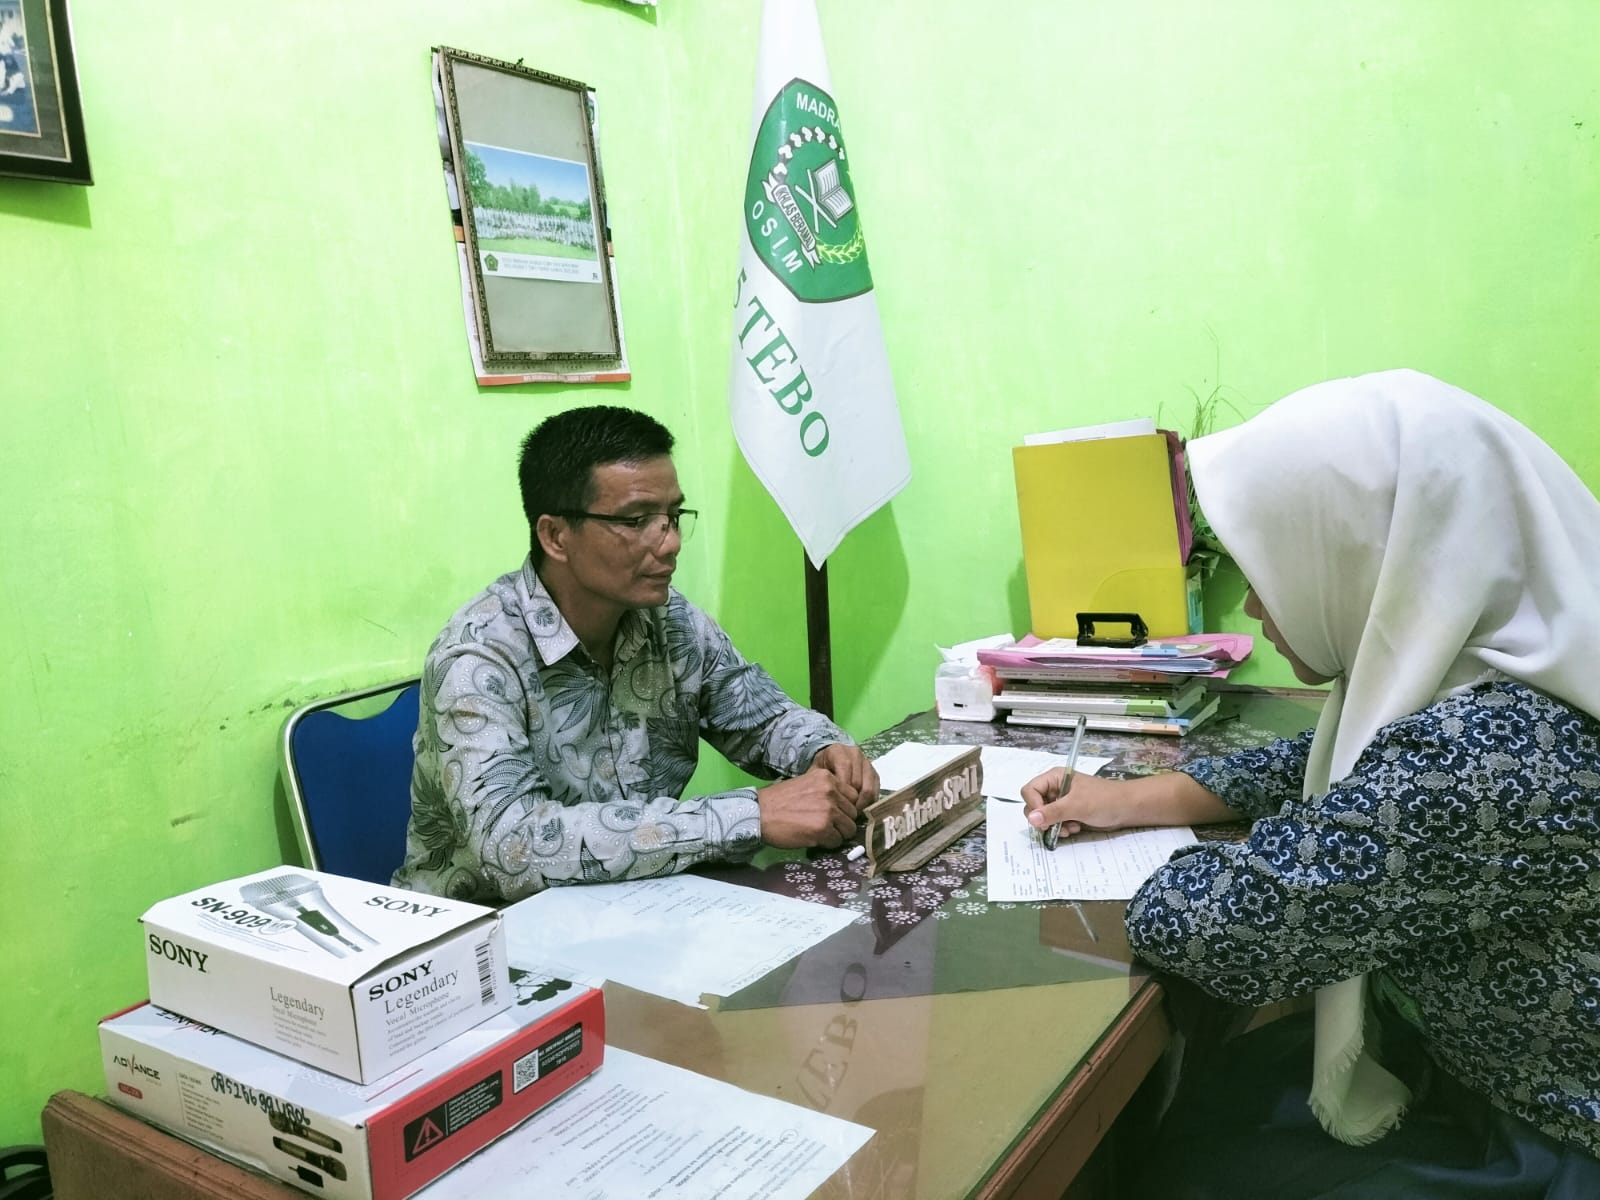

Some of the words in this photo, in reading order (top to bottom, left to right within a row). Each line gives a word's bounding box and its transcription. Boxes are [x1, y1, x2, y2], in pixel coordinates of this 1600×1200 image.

[752, 200, 803, 273] OSIM
[790, 210, 816, 250] BERAMAL
[738, 296, 830, 457] TEBO
[191, 897, 272, 928] SN-909
[363, 895, 452, 917] SONY
[148, 934, 209, 973] SONY
[368, 959, 433, 1002] SONY
[384, 969, 459, 1016] Legendary
[270, 986, 325, 1021] Legendary
[112, 1053, 161, 1080] ADVANCE
